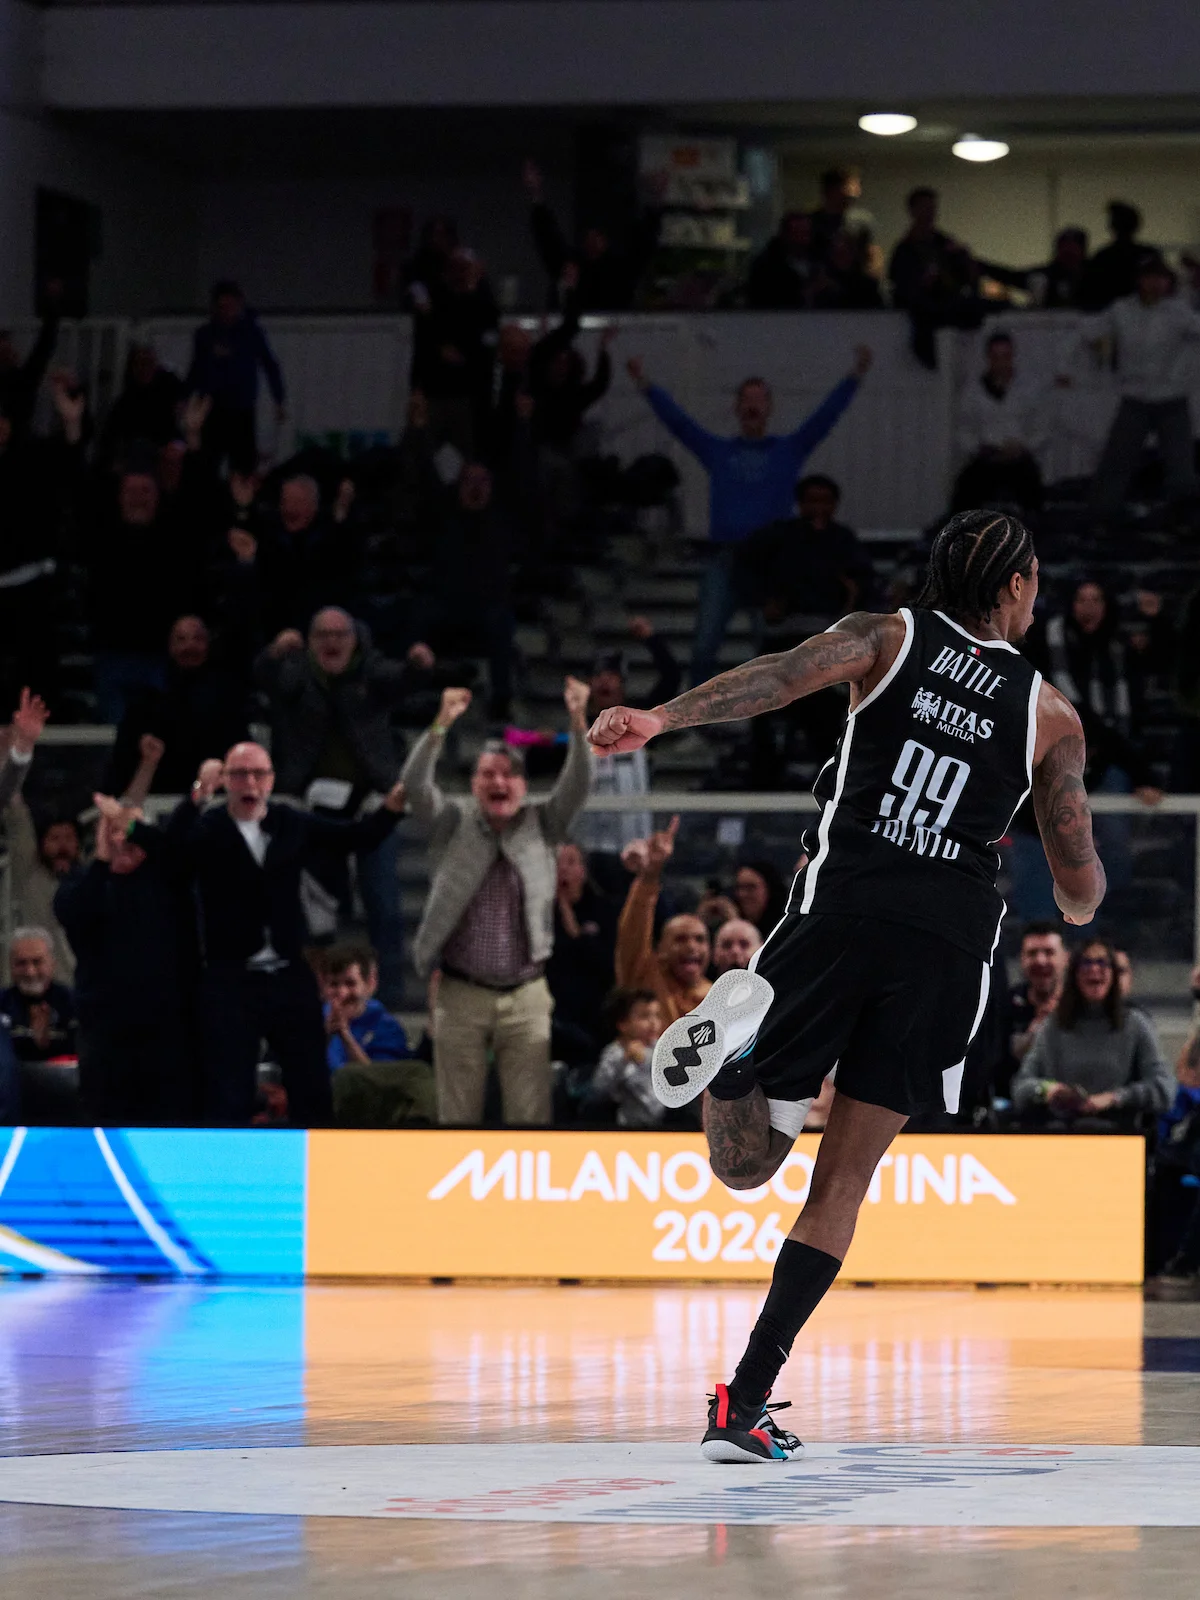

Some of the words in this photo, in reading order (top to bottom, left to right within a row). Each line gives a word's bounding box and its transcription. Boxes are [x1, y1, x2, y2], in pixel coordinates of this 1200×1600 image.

[927, 645, 1008, 700] BATTLE
[936, 720, 975, 744] MUTUA
[940, 699, 995, 740] ITAS
[879, 739, 972, 834] 99
[427, 1149, 712, 1203] MILANO
[725, 1151, 1018, 1205] OTINA
[652, 1210, 786, 1263] 2026
